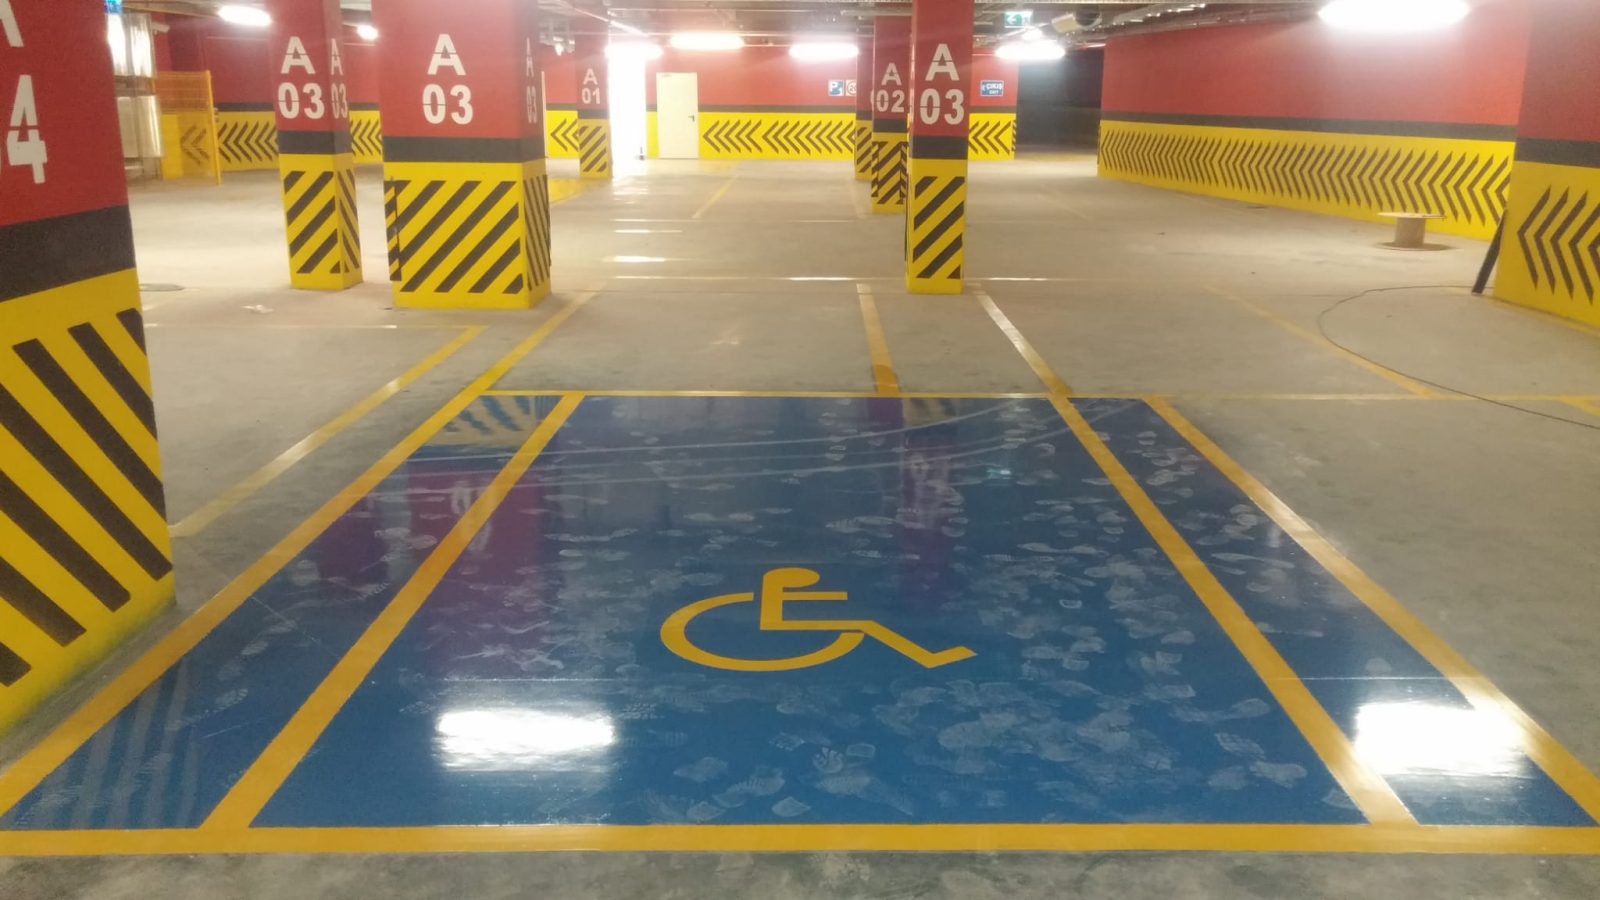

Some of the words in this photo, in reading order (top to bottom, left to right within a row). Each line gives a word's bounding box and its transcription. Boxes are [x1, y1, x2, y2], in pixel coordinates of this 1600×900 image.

[281, 36, 317, 74] A
[331, 38, 344, 76] A
[427, 33, 466, 76] A
[925, 43, 960, 81] A
[583, 67, 598, 85] A
[881, 62, 902, 86] A
[278, 82, 325, 119] 03
[331, 83, 349, 119] 03
[422, 83, 474, 125] 03
[581, 87, 601, 105] 01
[876, 89, 905, 113] 02
[920, 88, 965, 125] 03
[0, 75, 48, 184] 4
